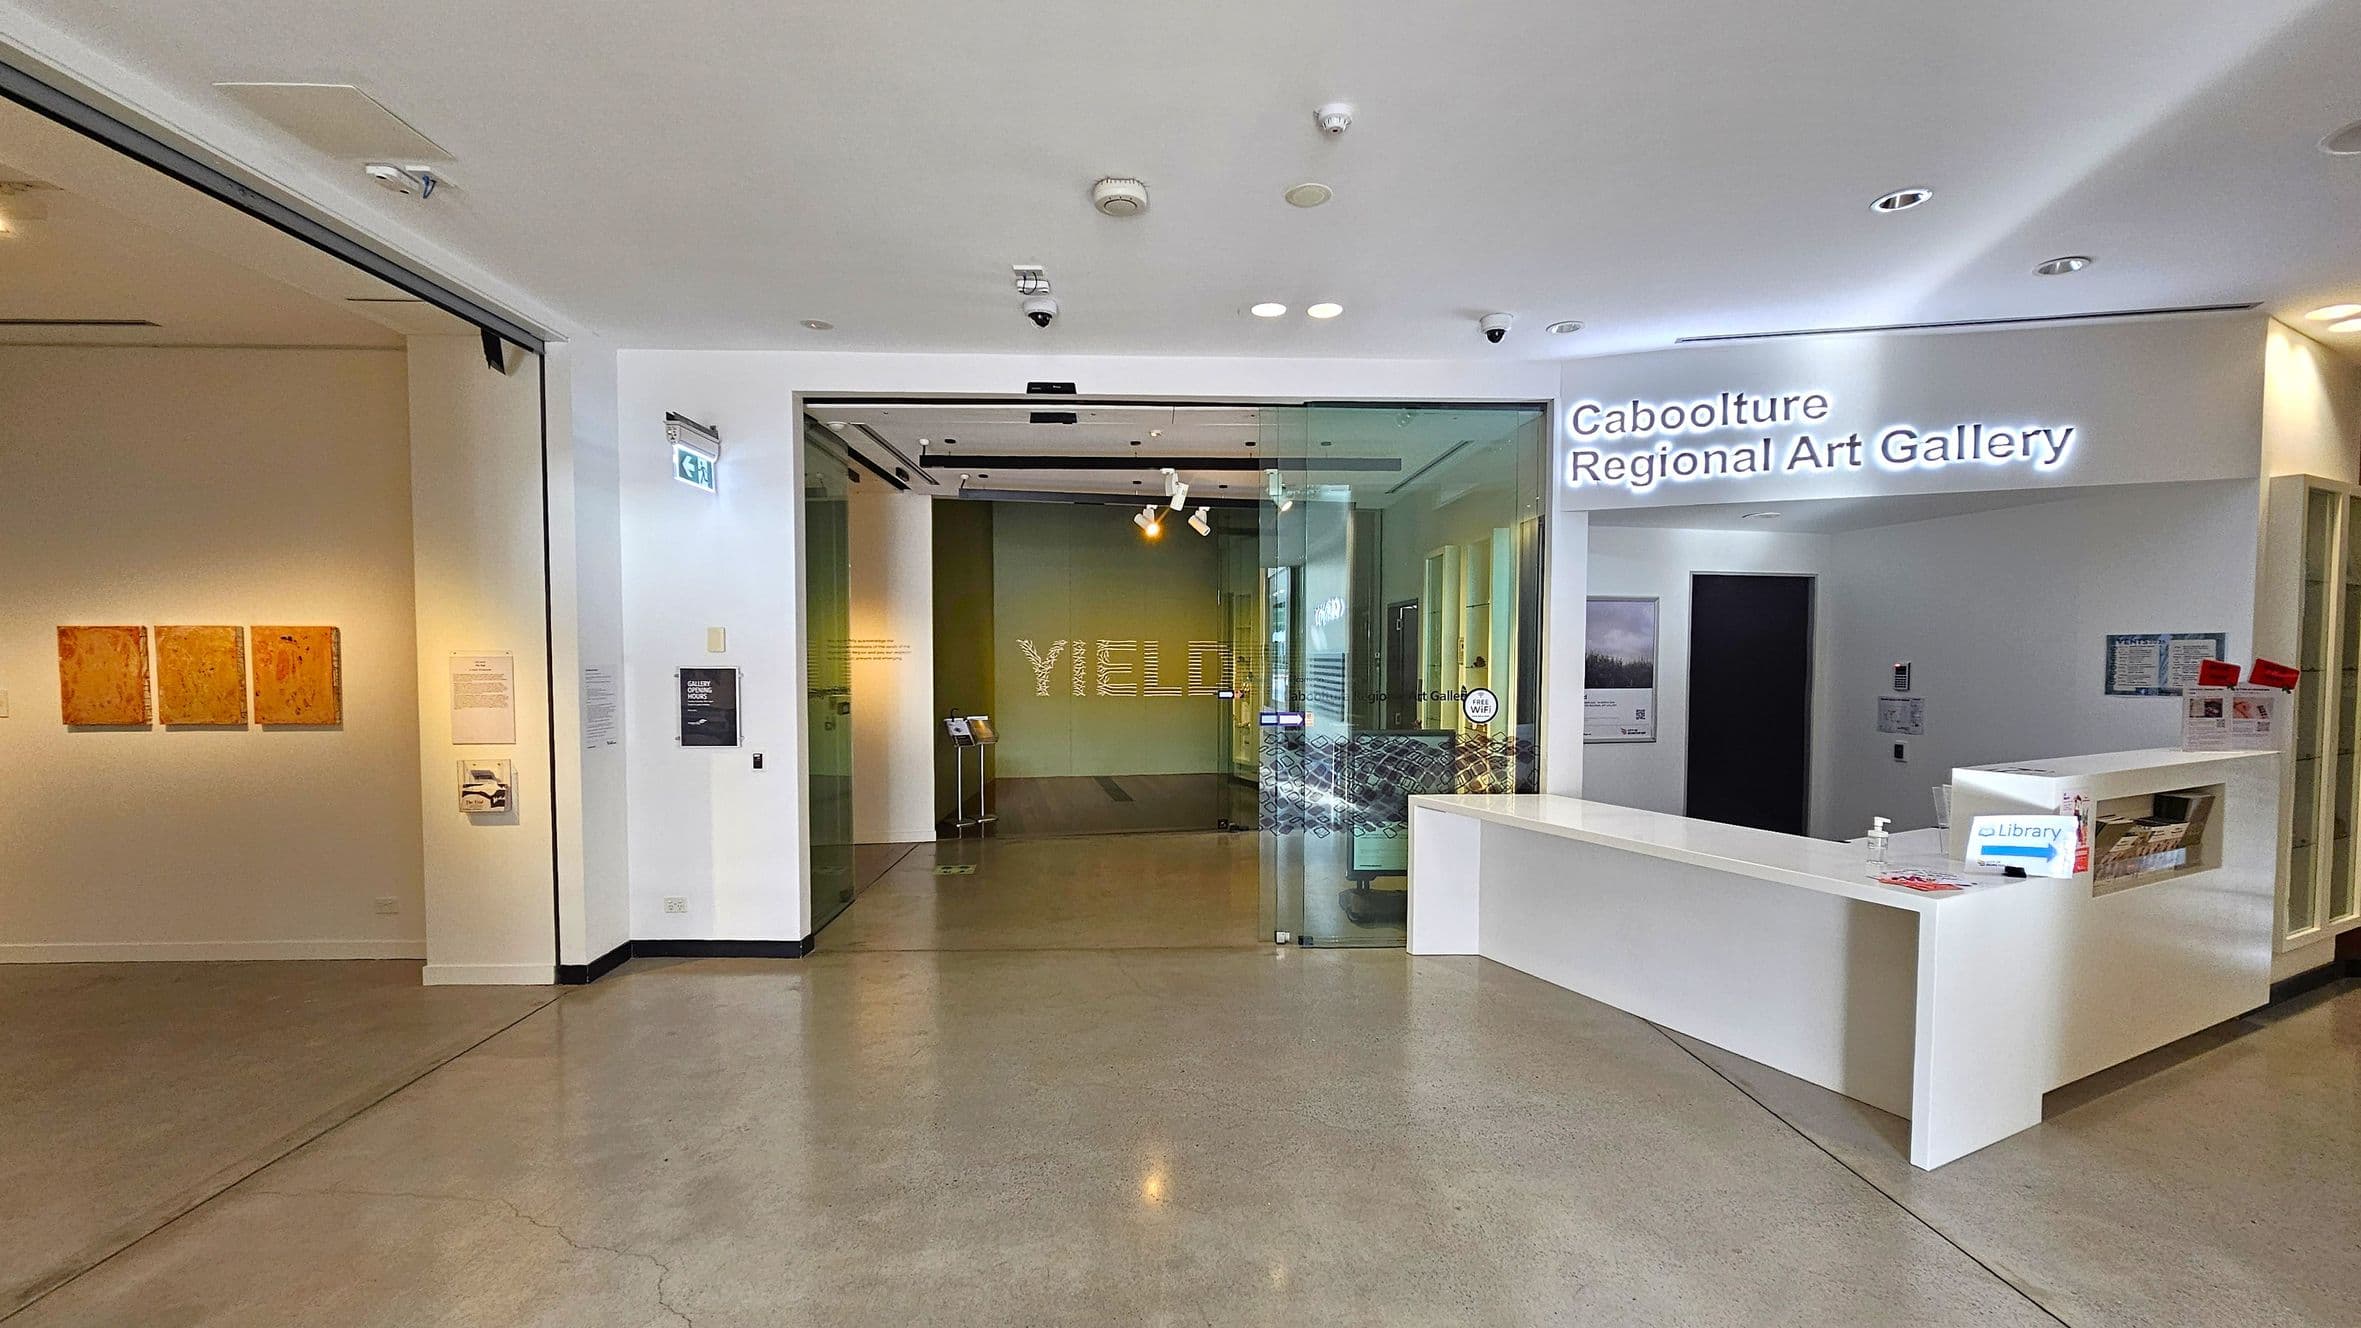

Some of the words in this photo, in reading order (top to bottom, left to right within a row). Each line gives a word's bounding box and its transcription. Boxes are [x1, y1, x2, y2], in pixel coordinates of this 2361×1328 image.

[1572, 392, 1828, 435] Caboolture
[1572, 437, 1771, 487] Regional
[1786, 432, 1863, 470] Art
[1881, 424, 2075, 464] Gallery
[1016, 639, 1234, 697] YIELD
[1470, 705, 1492, 714] WiFi
[1999, 823, 2062, 841] Library
